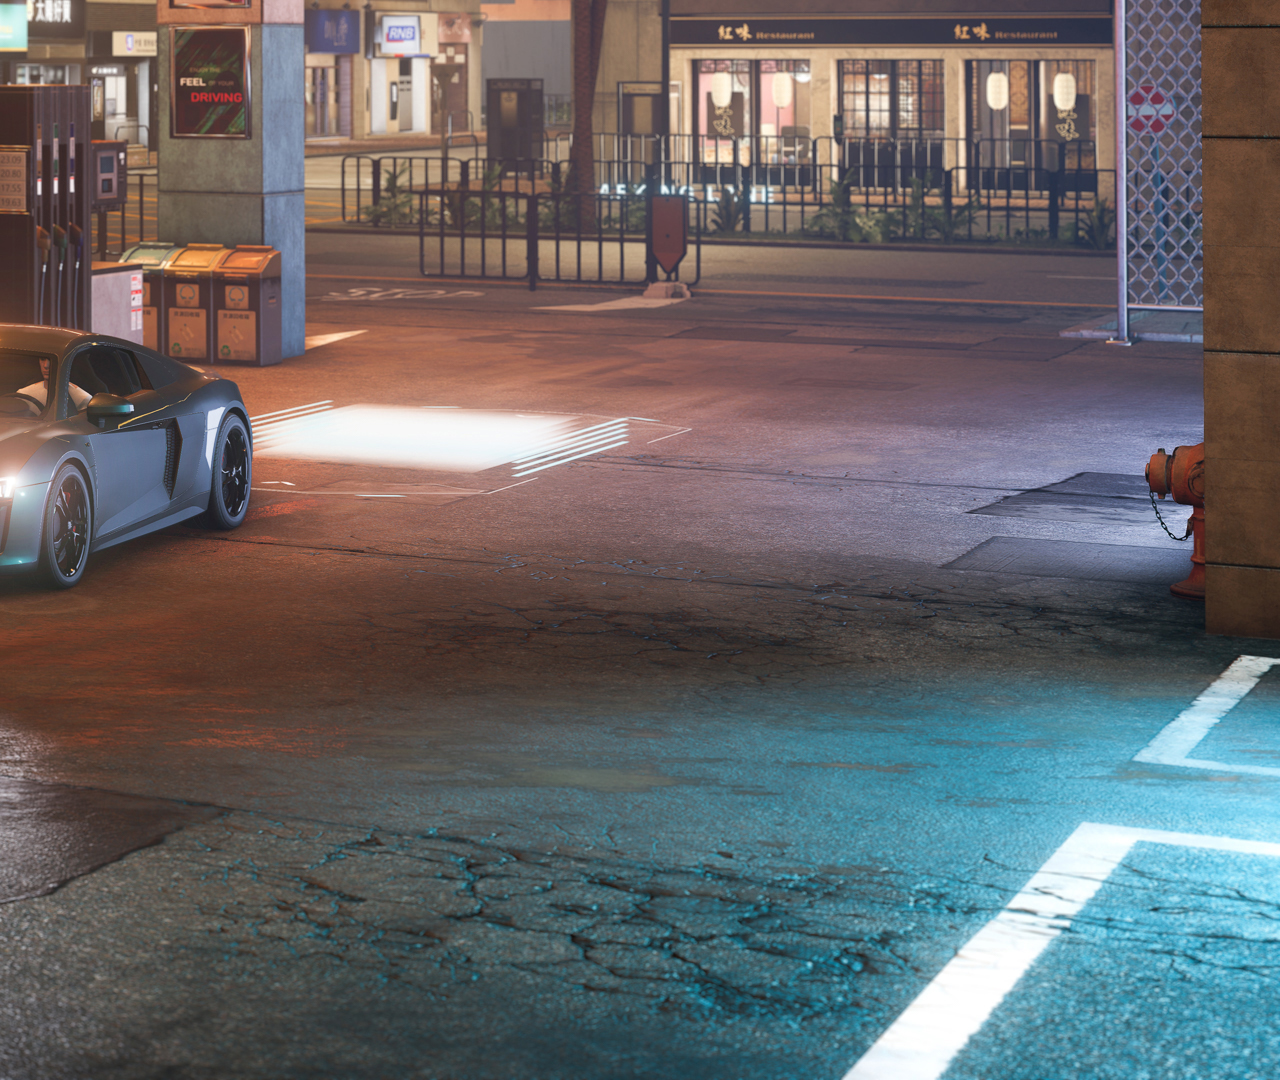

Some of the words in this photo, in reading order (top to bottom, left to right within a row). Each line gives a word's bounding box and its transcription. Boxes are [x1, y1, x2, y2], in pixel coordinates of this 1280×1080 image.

[389, 27, 414, 39] RNB
[717, 22, 752, 41] 紅味
[756, 31, 815, 40] Restaurant
[954, 22, 990, 40] 紅味
[994, 31, 1058, 40] Restaurant
[180, 77, 207, 87] FEEL
[191, 92, 243, 103] DRIVING
[1, 156, 22, 164] 23.09
[1, 169, 22, 178] 20.80
[1, 184, 22, 193] 17.55
[1, 198, 22, 207] 19.63
